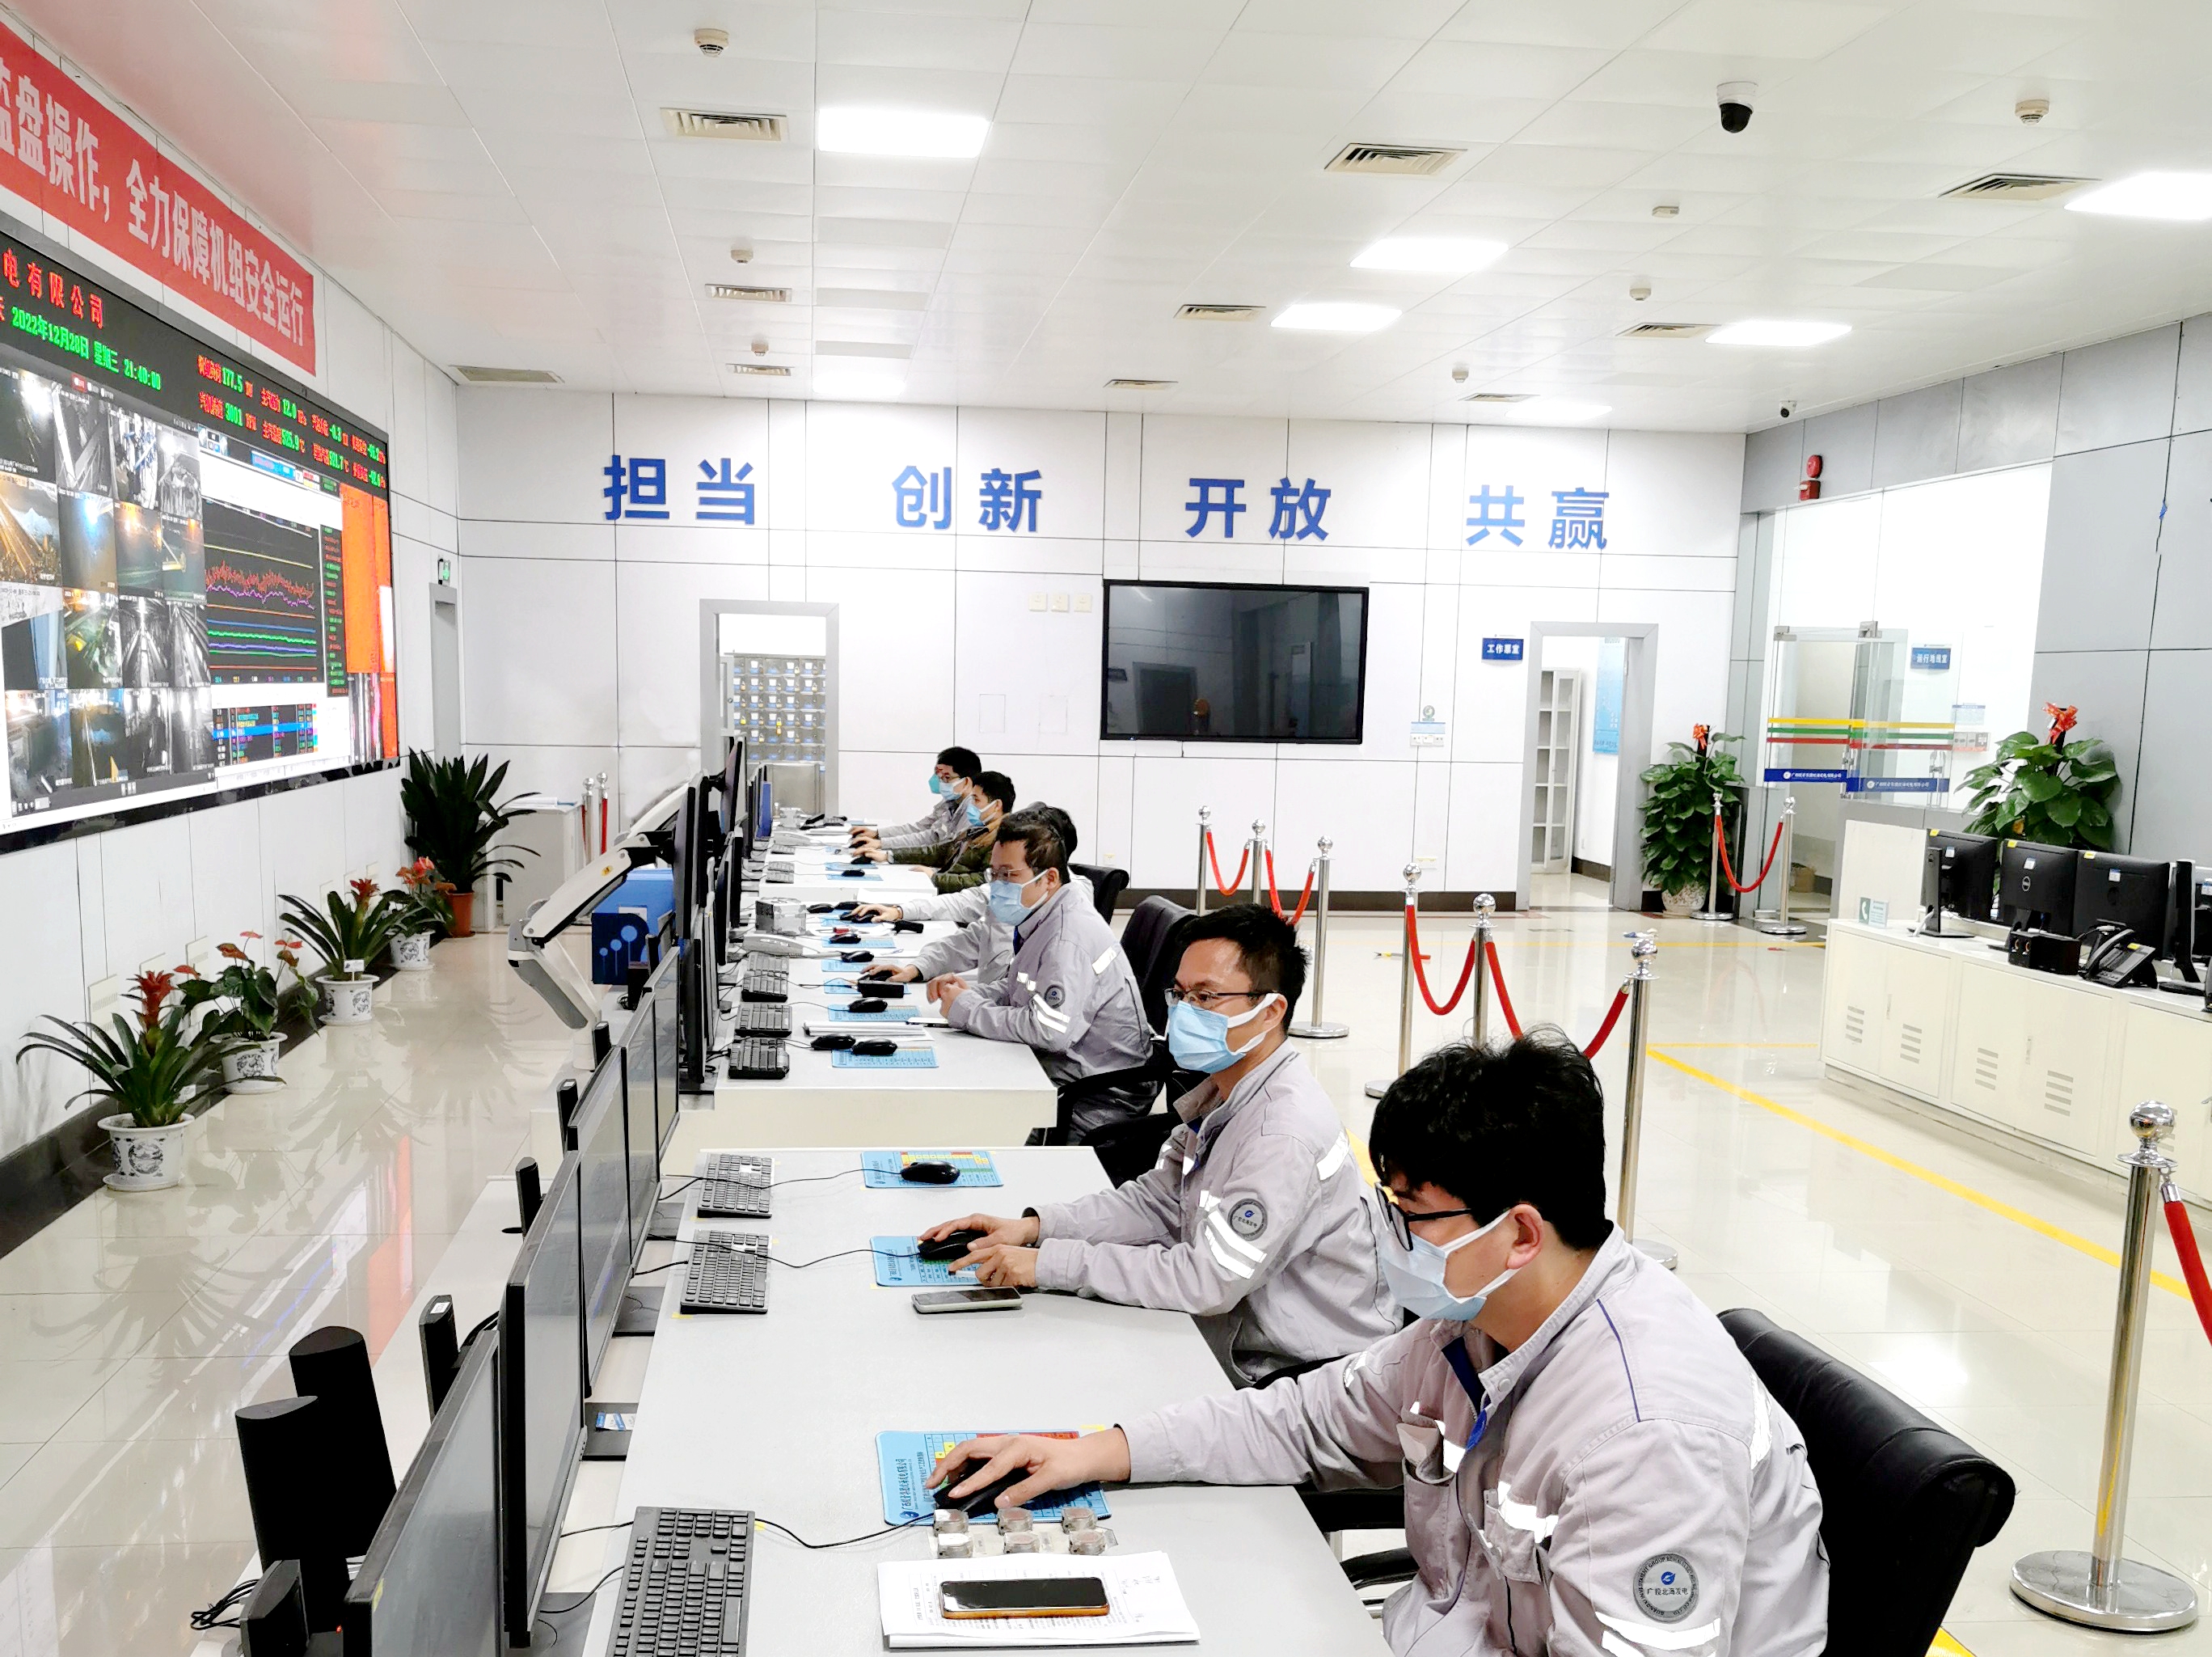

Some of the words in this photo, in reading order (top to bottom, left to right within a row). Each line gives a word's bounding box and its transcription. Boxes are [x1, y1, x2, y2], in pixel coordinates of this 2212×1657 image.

[3, 247, 103, 329] 电有限公司
[94, 340, 119, 374] 星期三
[602, 454, 755, 525] 担当
[892, 465, 1043, 532] 创新
[1184, 477, 1332, 542] 开放
[1465, 484, 1610, 550] 共赢
[1647, 1587, 1689, 1596] 广投北海发电
